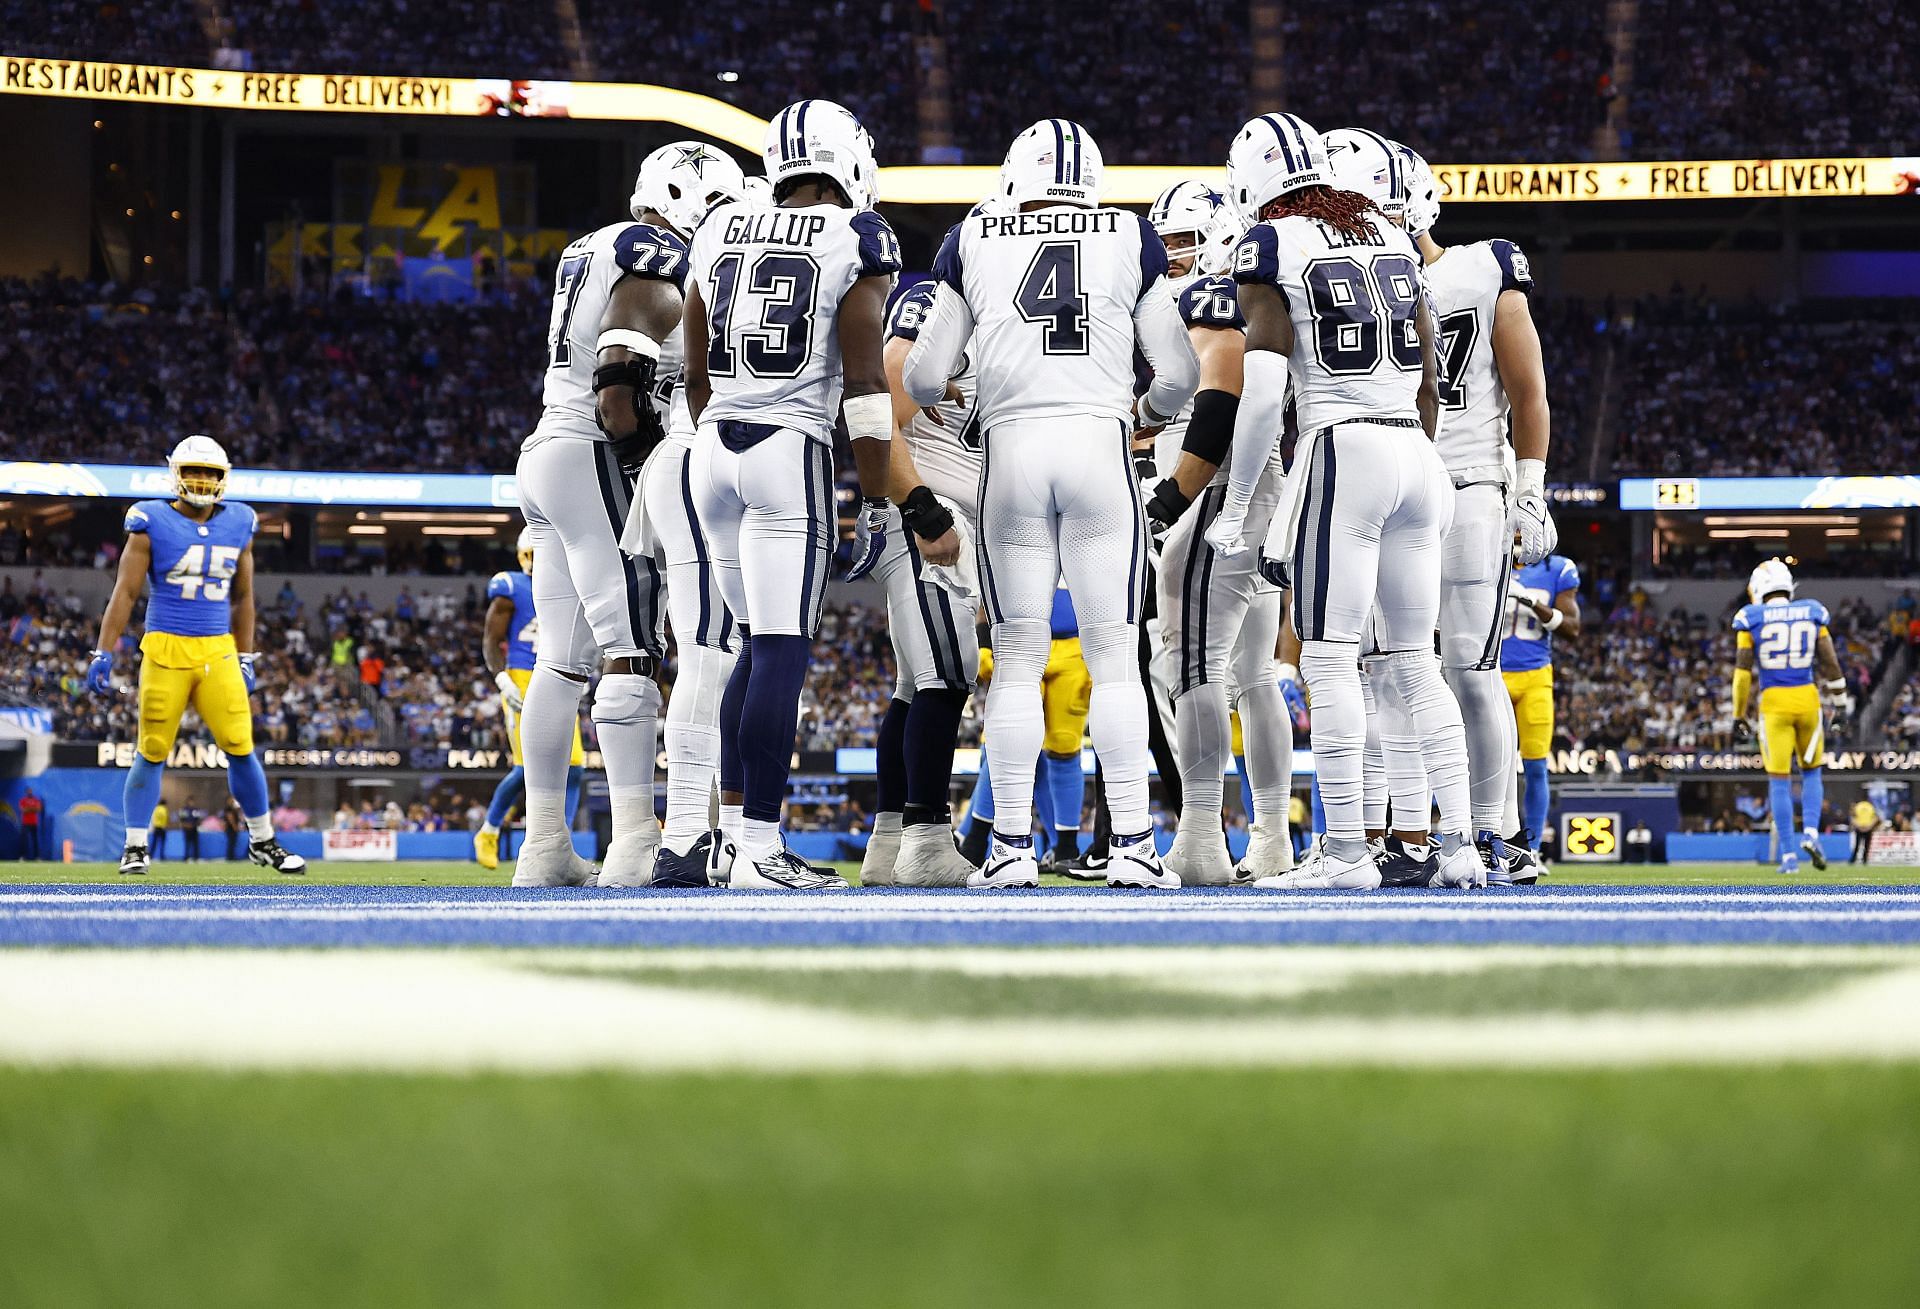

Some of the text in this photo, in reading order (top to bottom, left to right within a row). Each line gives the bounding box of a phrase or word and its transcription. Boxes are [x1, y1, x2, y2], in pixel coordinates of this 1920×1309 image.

[7, 62, 449, 113] RESTAURANTS FREE DELIVERY!
[779, 160, 812, 172] COWBOYS
[1282, 173, 1321, 188] COWBOYS
[1440, 165, 1866, 196] STAURANTS FREE DELIVERY!
[368, 164, 501, 250] LA
[1047, 188, 1085, 198] COWBOYS
[723, 214, 825, 246] GALLUP
[981, 211, 1120, 238] PRESCOTT
[632, 241, 683, 277] 77
[549, 251, 595, 369] 7
[708, 252, 820, 380] 13
[1012, 239, 1090, 356] 4
[1190, 290, 1236, 319] 70
[1302, 254, 1424, 376] 88
[165, 544, 241, 600] 45
[1759, 621, 1817, 669] 20
[335, 750, 401, 766] CASINO
[447, 750, 500, 768] PLAY
[1567, 817, 1615, 855] 25
